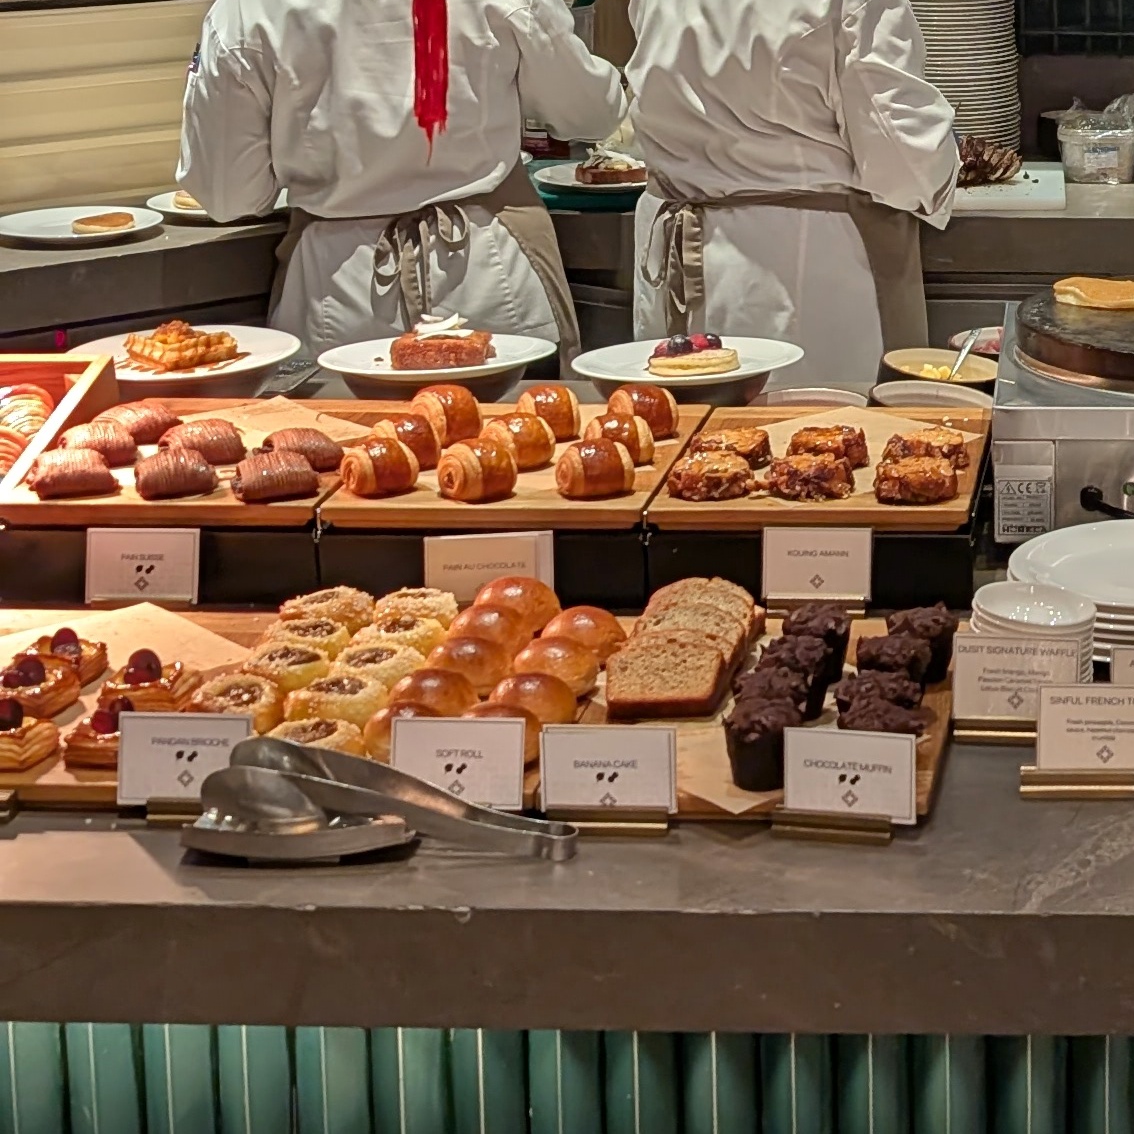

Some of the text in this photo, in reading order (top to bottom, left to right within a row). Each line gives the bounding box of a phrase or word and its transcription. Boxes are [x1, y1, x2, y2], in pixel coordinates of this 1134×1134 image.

[986, 646, 1037, 656] SIGNATURE
[1040, 648, 1077, 657] WAFFLE
[1050, 696, 1083, 705] SINFUL
[1086, 696, 1125, 706] FRENCH
[435, 749, 484, 759] SOFT ROLL
[573, 759, 637, 769] BANANA CAKE
[803, 759, 892, 774] CHOCOLATE MUFFIN
